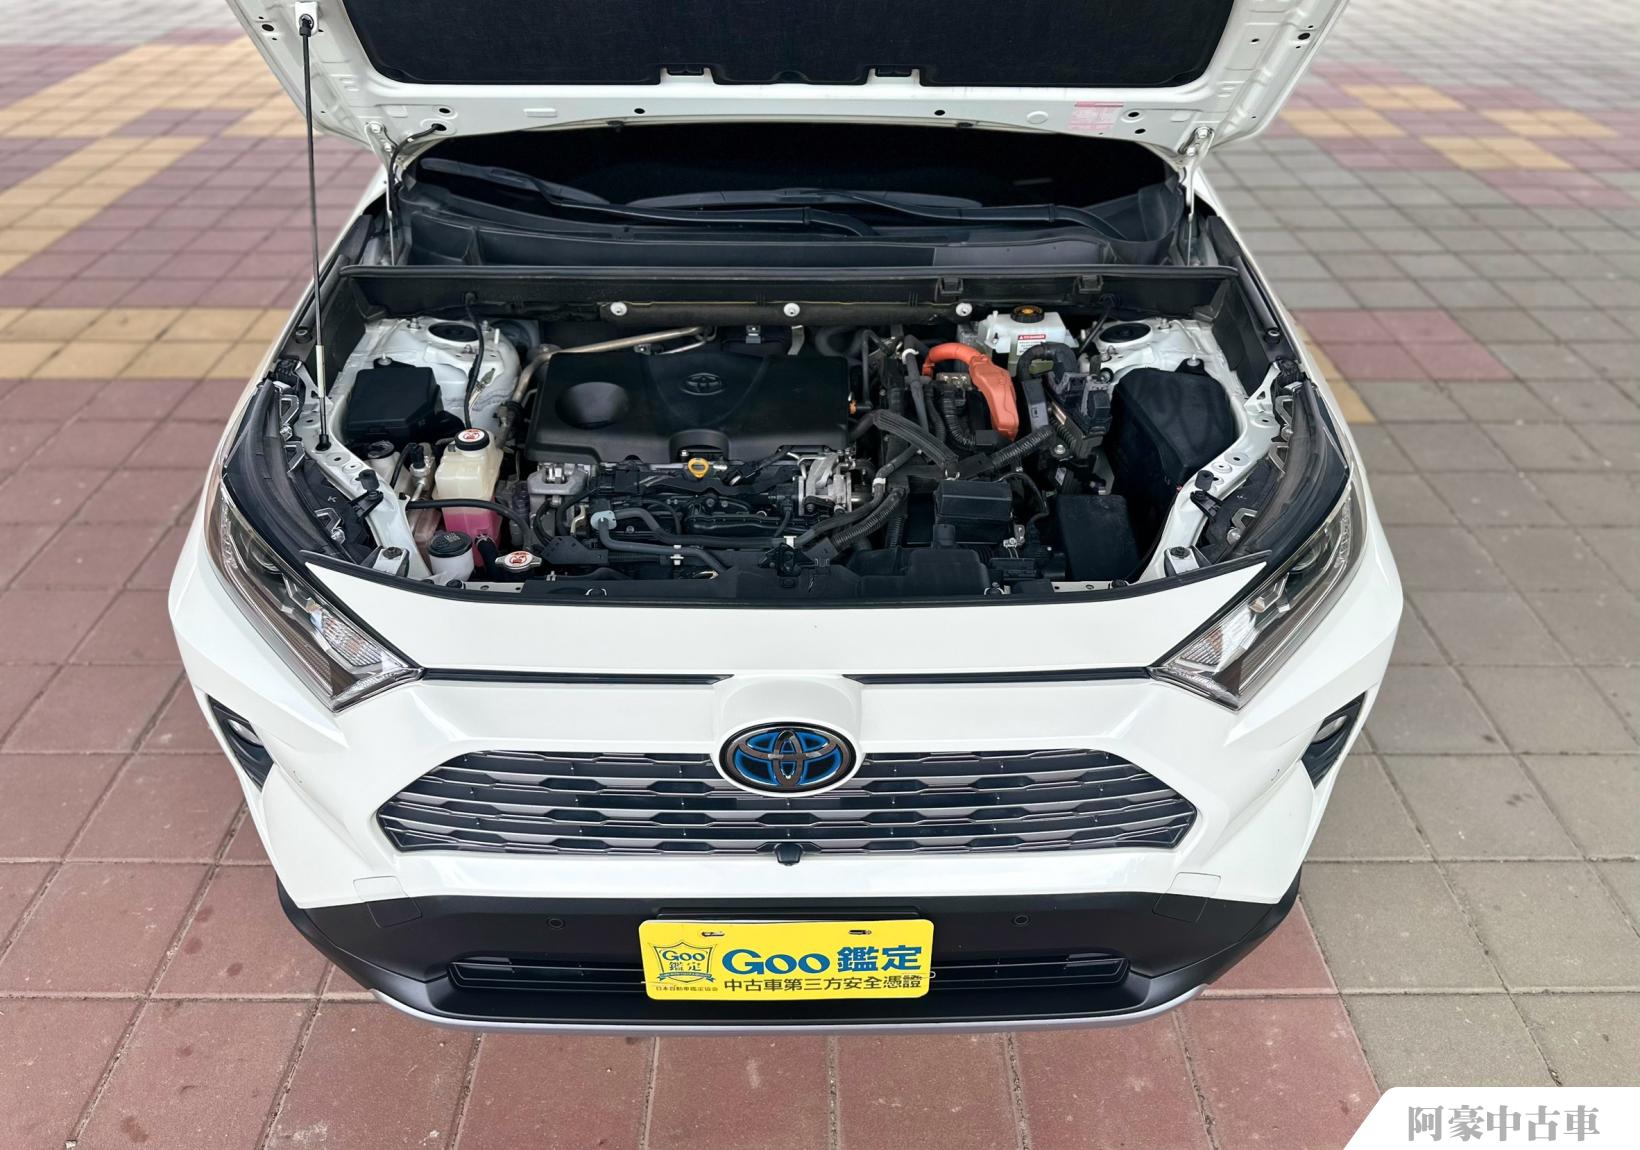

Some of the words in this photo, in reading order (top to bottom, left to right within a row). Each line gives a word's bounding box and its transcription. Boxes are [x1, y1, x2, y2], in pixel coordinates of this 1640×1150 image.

[662, 950, 705, 961] Goo
[722, 949, 830, 974] Goo
[837, 945, 922, 972] 鑑定
[724, 975, 922, 992] 中古車第三方安全憑證
